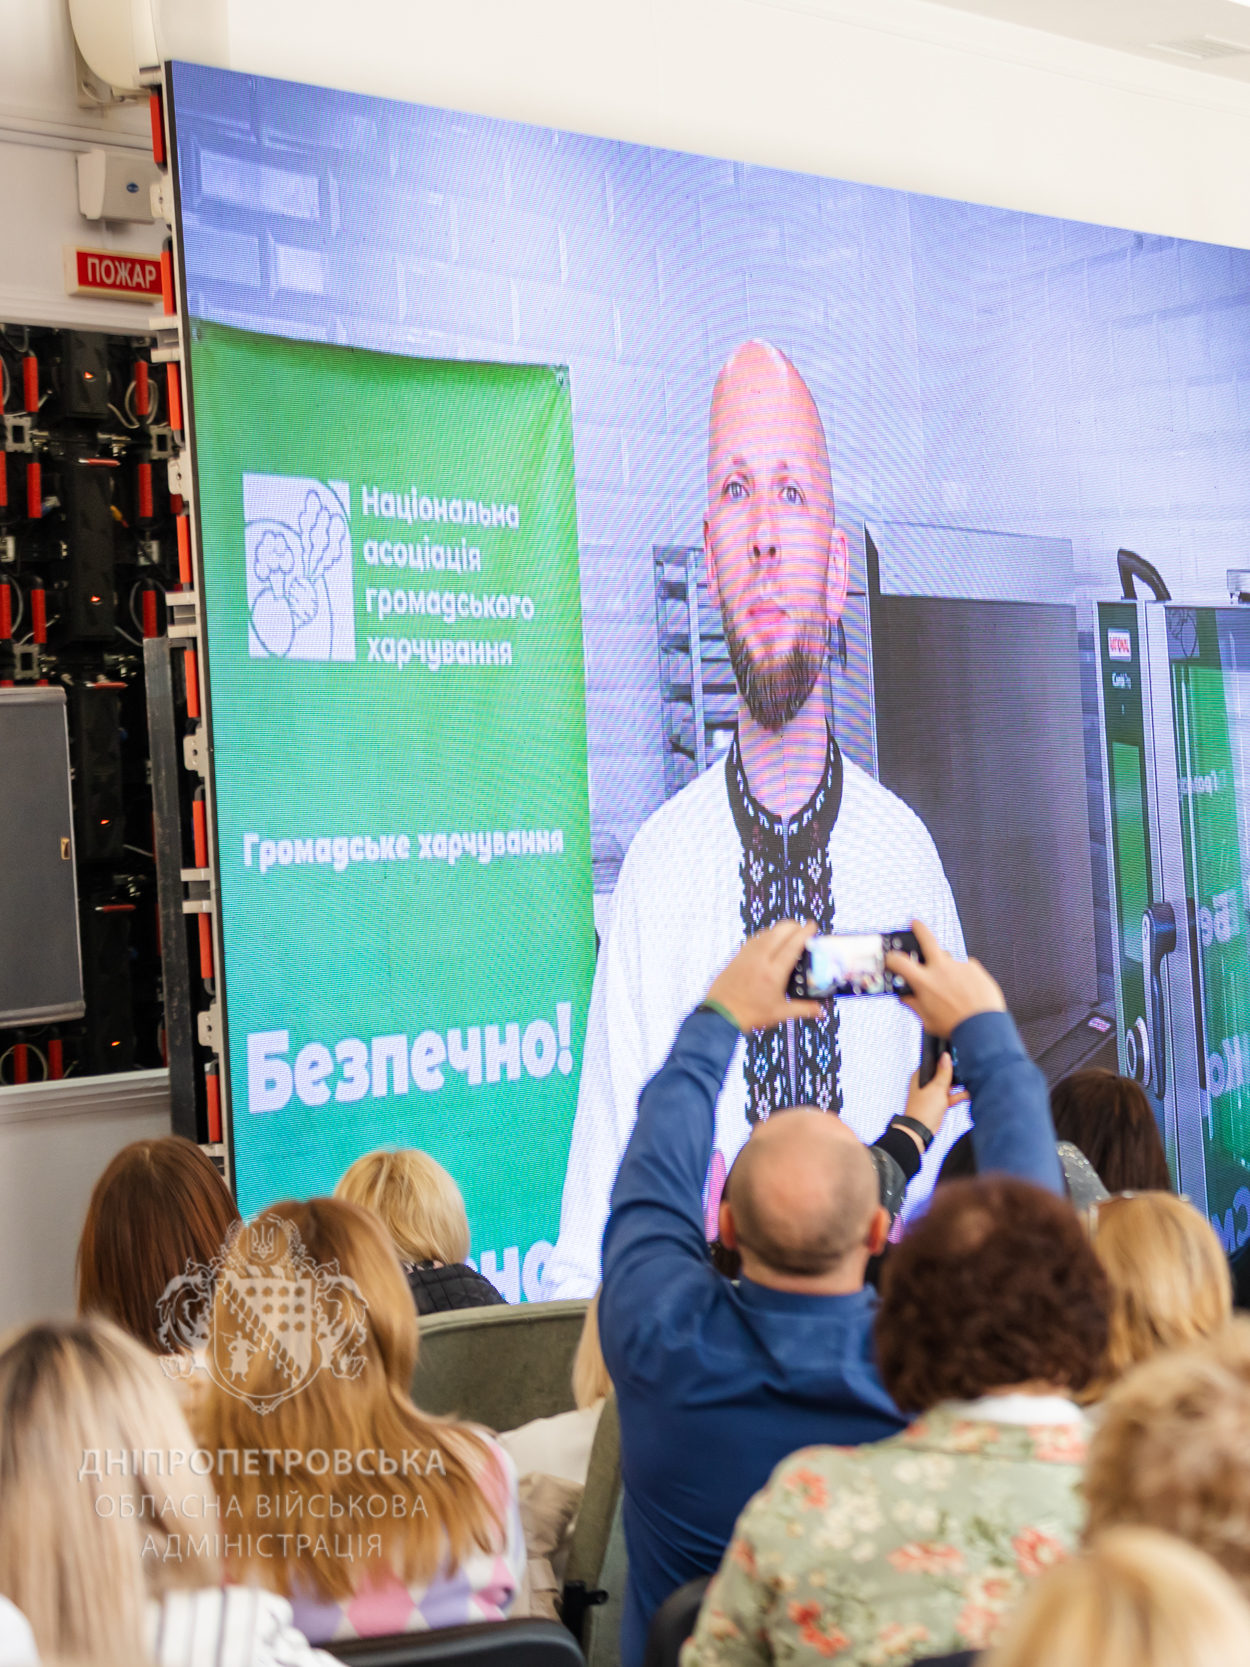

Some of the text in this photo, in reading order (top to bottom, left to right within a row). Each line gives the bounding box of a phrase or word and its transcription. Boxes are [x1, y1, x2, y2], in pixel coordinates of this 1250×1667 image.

[86, 256, 157, 289] ПОЖАР
[362, 484, 520, 529] Національна
[363, 534, 482, 575] асоціація
[365, 586, 535, 624] громадського
[367, 636, 513, 672] харчування
[243, 828, 564, 872] Громадське харчування
[246, 1002, 574, 1114] Безпечно!
